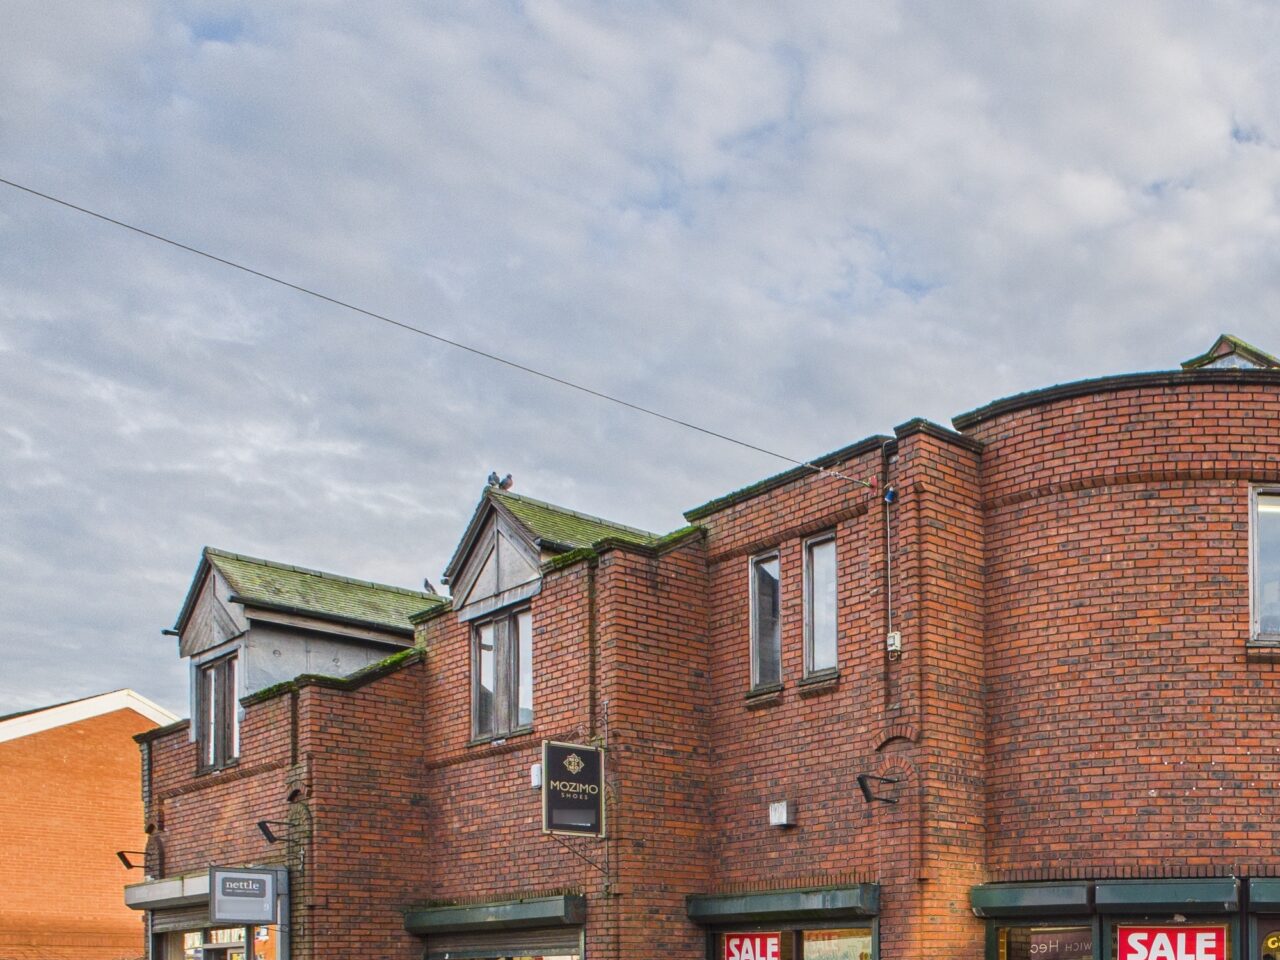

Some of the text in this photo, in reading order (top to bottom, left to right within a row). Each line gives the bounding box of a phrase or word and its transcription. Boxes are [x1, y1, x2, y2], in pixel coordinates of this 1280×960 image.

[550, 780, 599, 794] MOZIMO
[561, 792, 588, 800] SHOES
[226, 880, 260, 890] nettle
